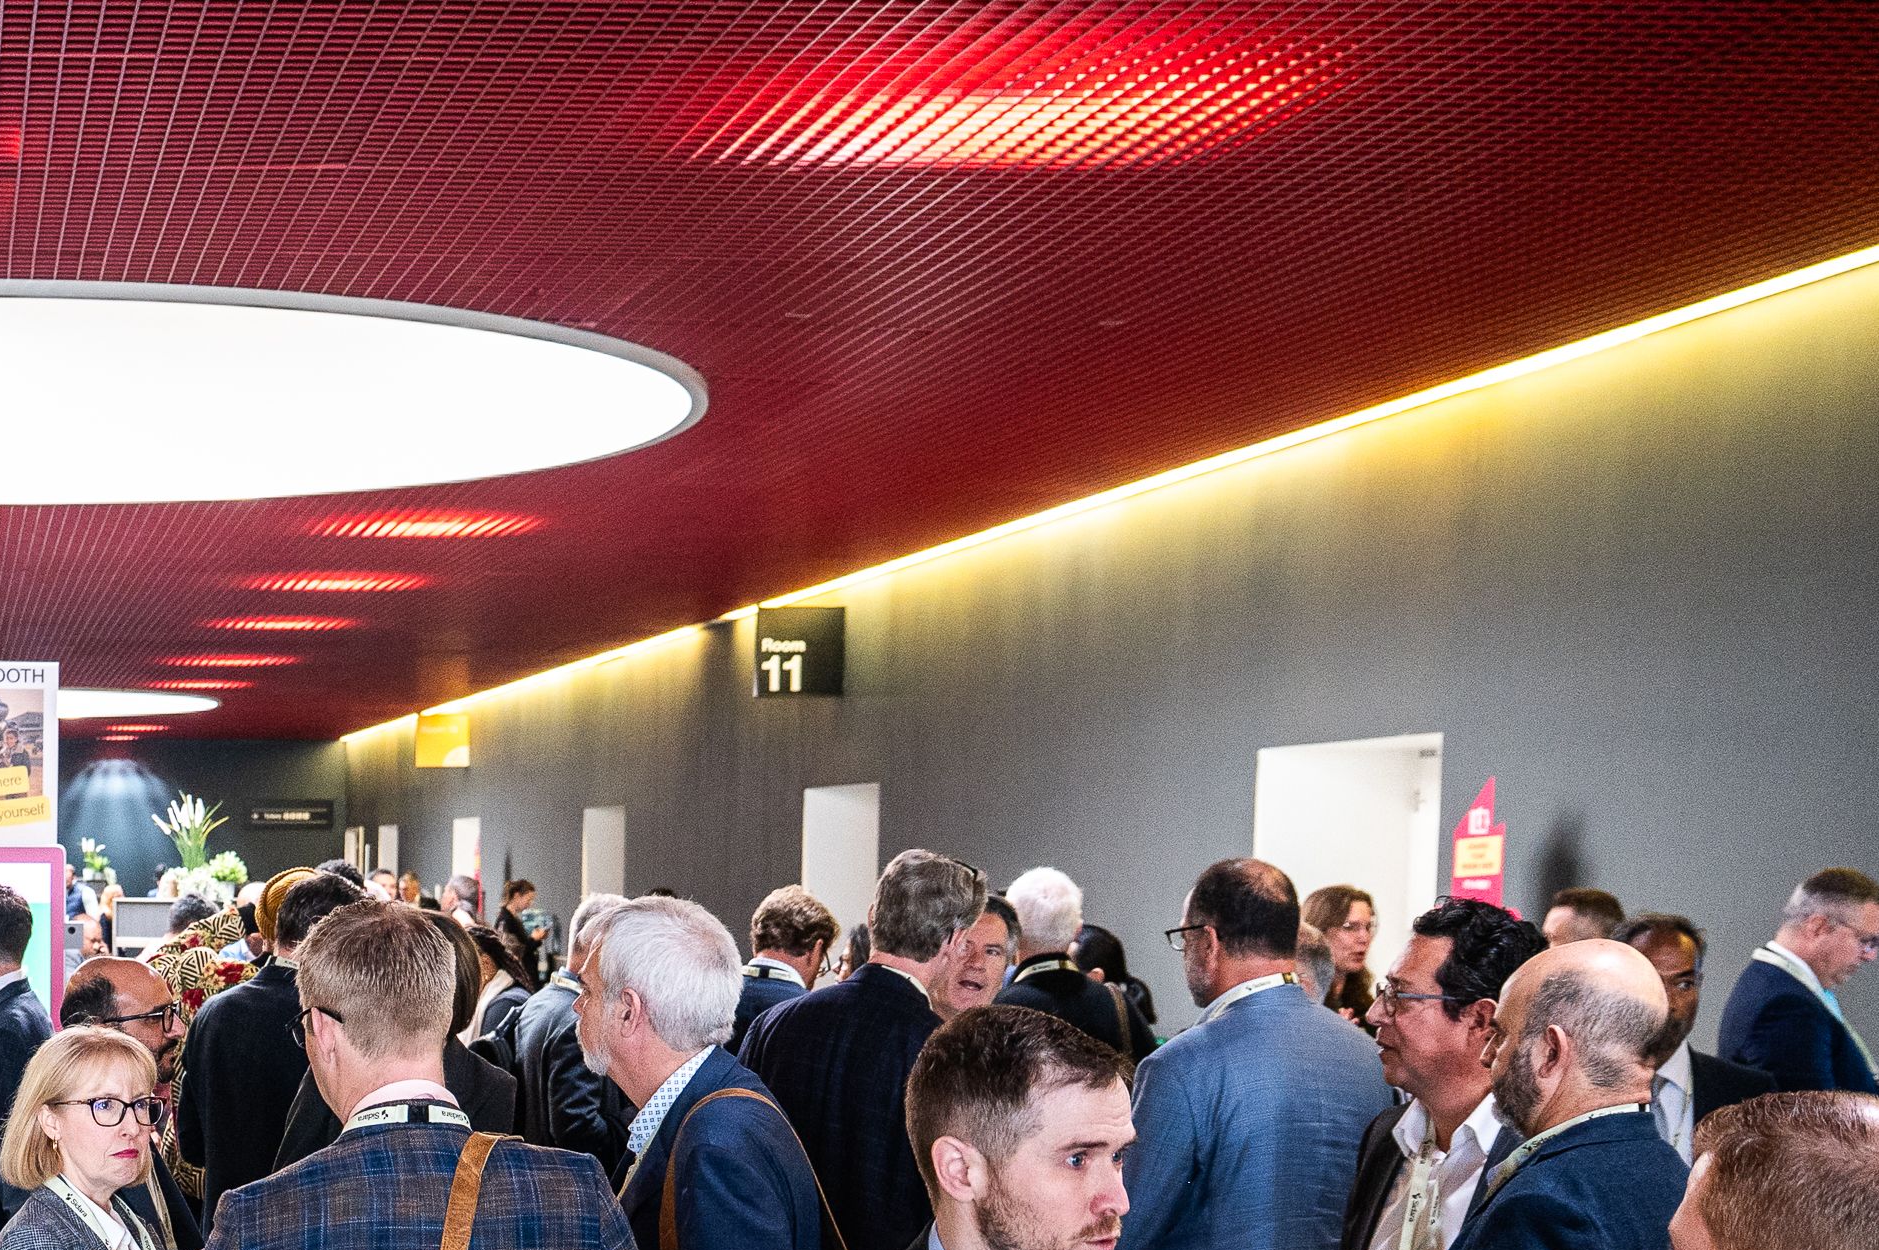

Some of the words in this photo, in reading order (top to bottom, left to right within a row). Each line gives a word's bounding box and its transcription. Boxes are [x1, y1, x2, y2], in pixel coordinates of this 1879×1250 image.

[761, 637, 806, 653] Room
[761, 654, 802, 692] 11
[358, 1112, 380, 1121] Sidara
[71, 1198, 88, 1218] Sidara
